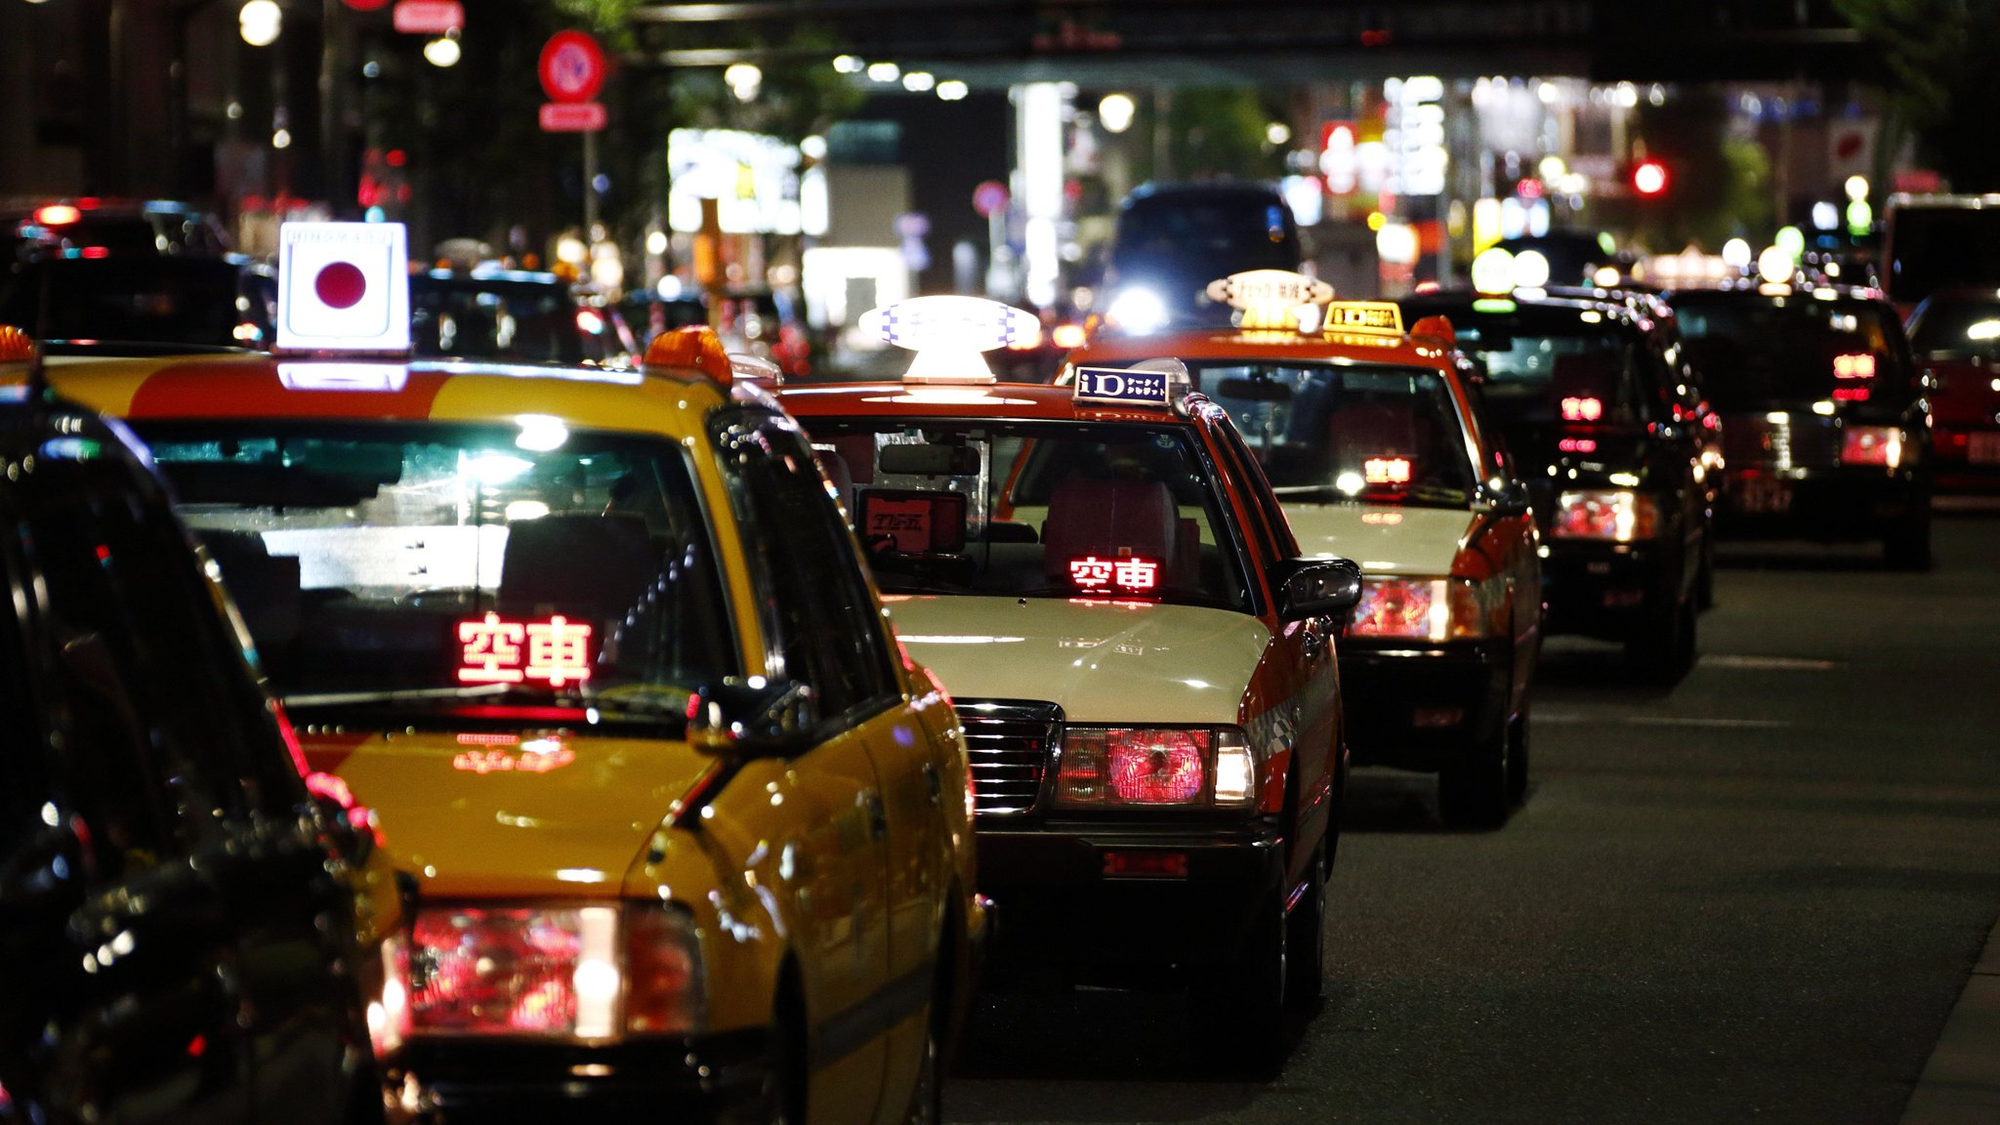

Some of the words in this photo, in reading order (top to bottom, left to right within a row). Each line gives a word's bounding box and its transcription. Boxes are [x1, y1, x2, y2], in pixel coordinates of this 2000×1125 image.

[1079, 374, 1125, 396] iD
[1127, 377, 1160, 387] ケータイ
[1070, 557, 1157, 593] 空車
[458, 611, 592, 687] 空車
